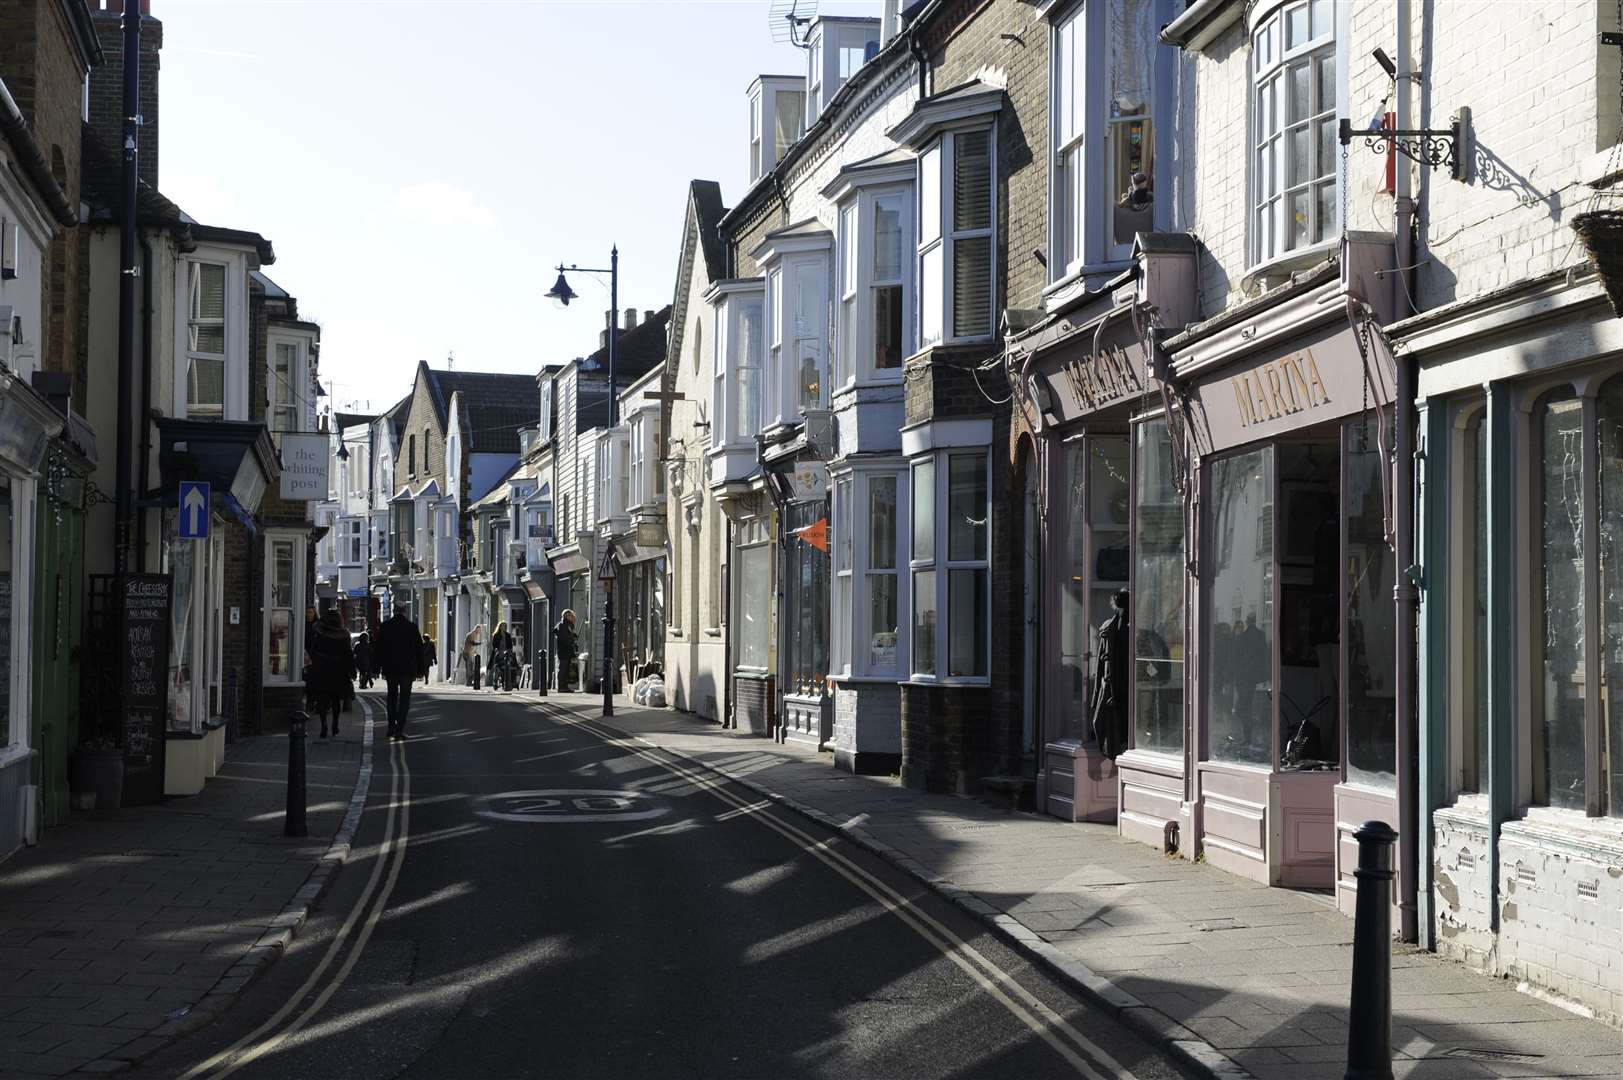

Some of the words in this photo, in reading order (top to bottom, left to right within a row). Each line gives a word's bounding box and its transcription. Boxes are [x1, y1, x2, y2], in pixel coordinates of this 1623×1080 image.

[1232, 347, 1330, 427] MARINA
[295, 448, 316, 460] the
[290, 480, 317, 492] post
